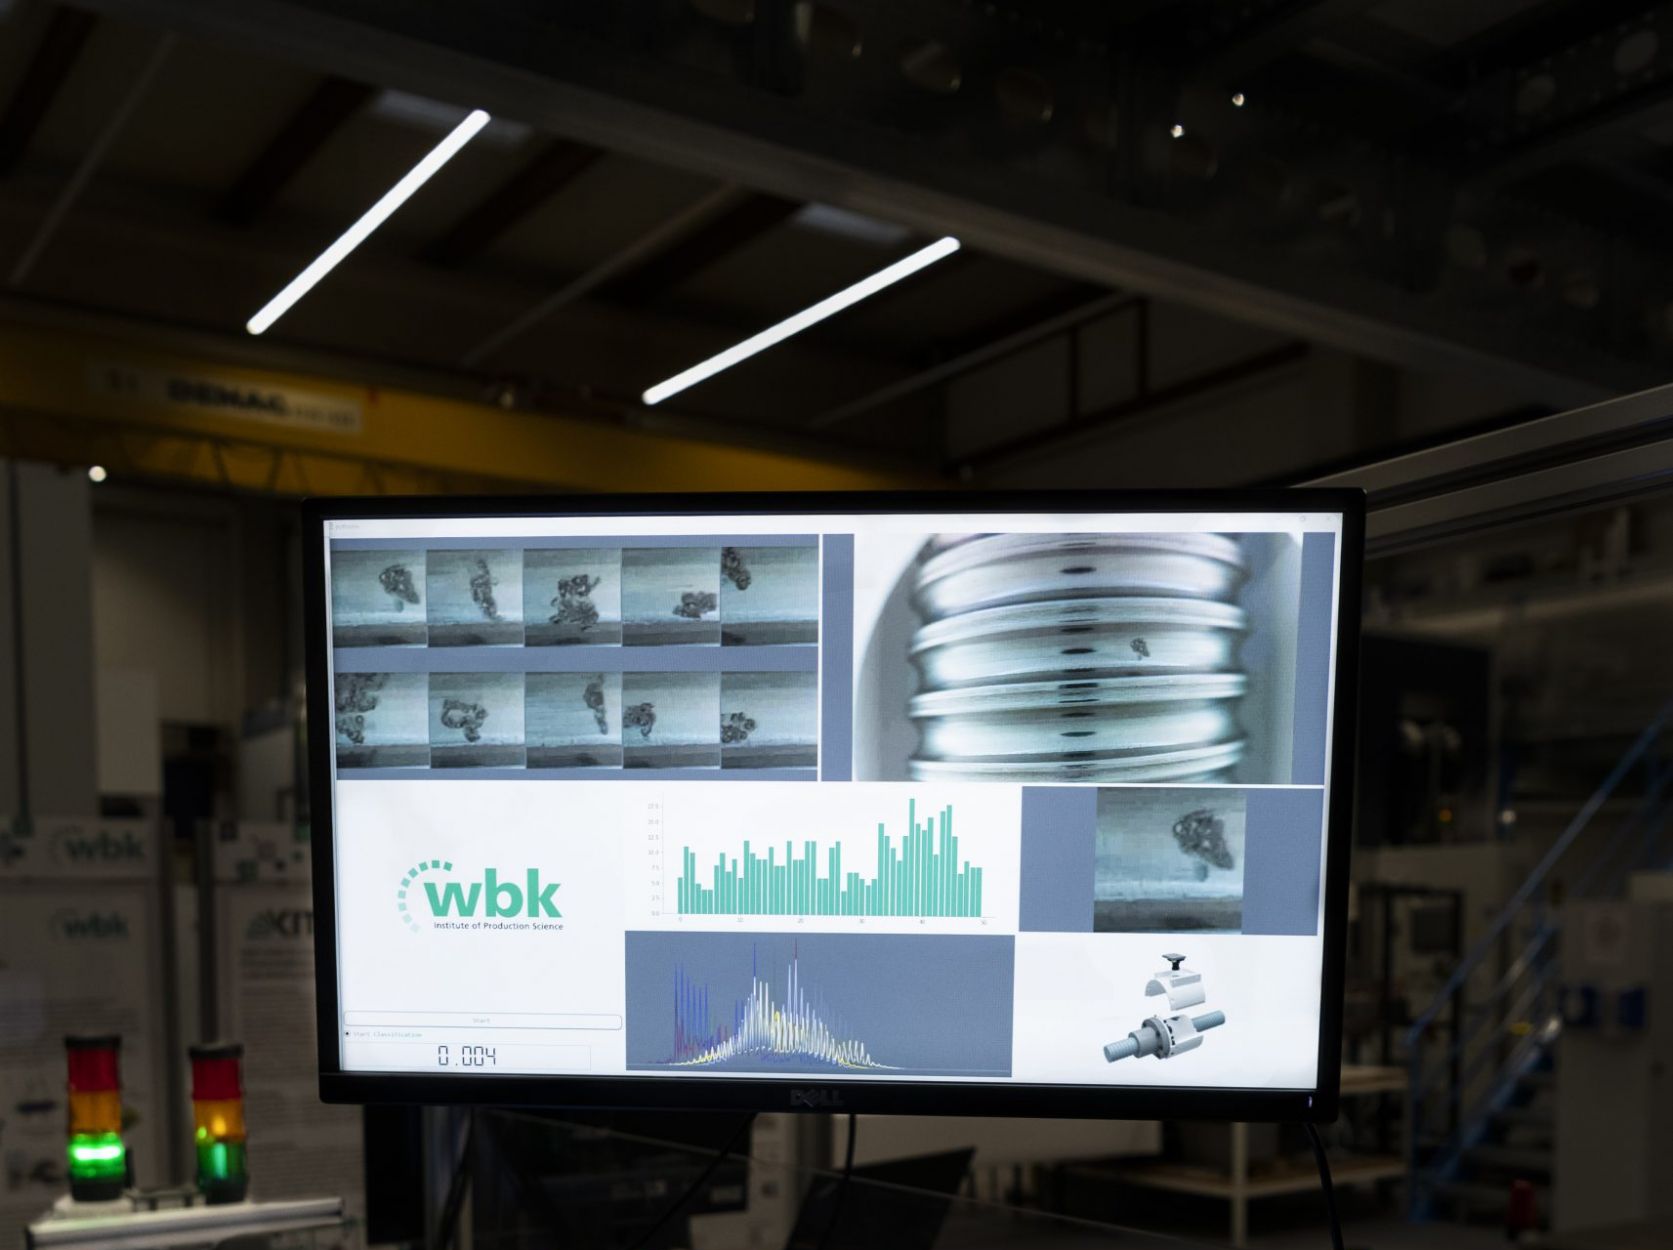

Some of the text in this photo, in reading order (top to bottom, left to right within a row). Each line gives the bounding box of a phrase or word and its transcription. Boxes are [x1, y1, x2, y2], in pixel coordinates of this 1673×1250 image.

[424, 868, 562, 918] wbk
[434, 922, 564, 931] Institute of Production Science
[790, 1088, 844, 1107] DELL
